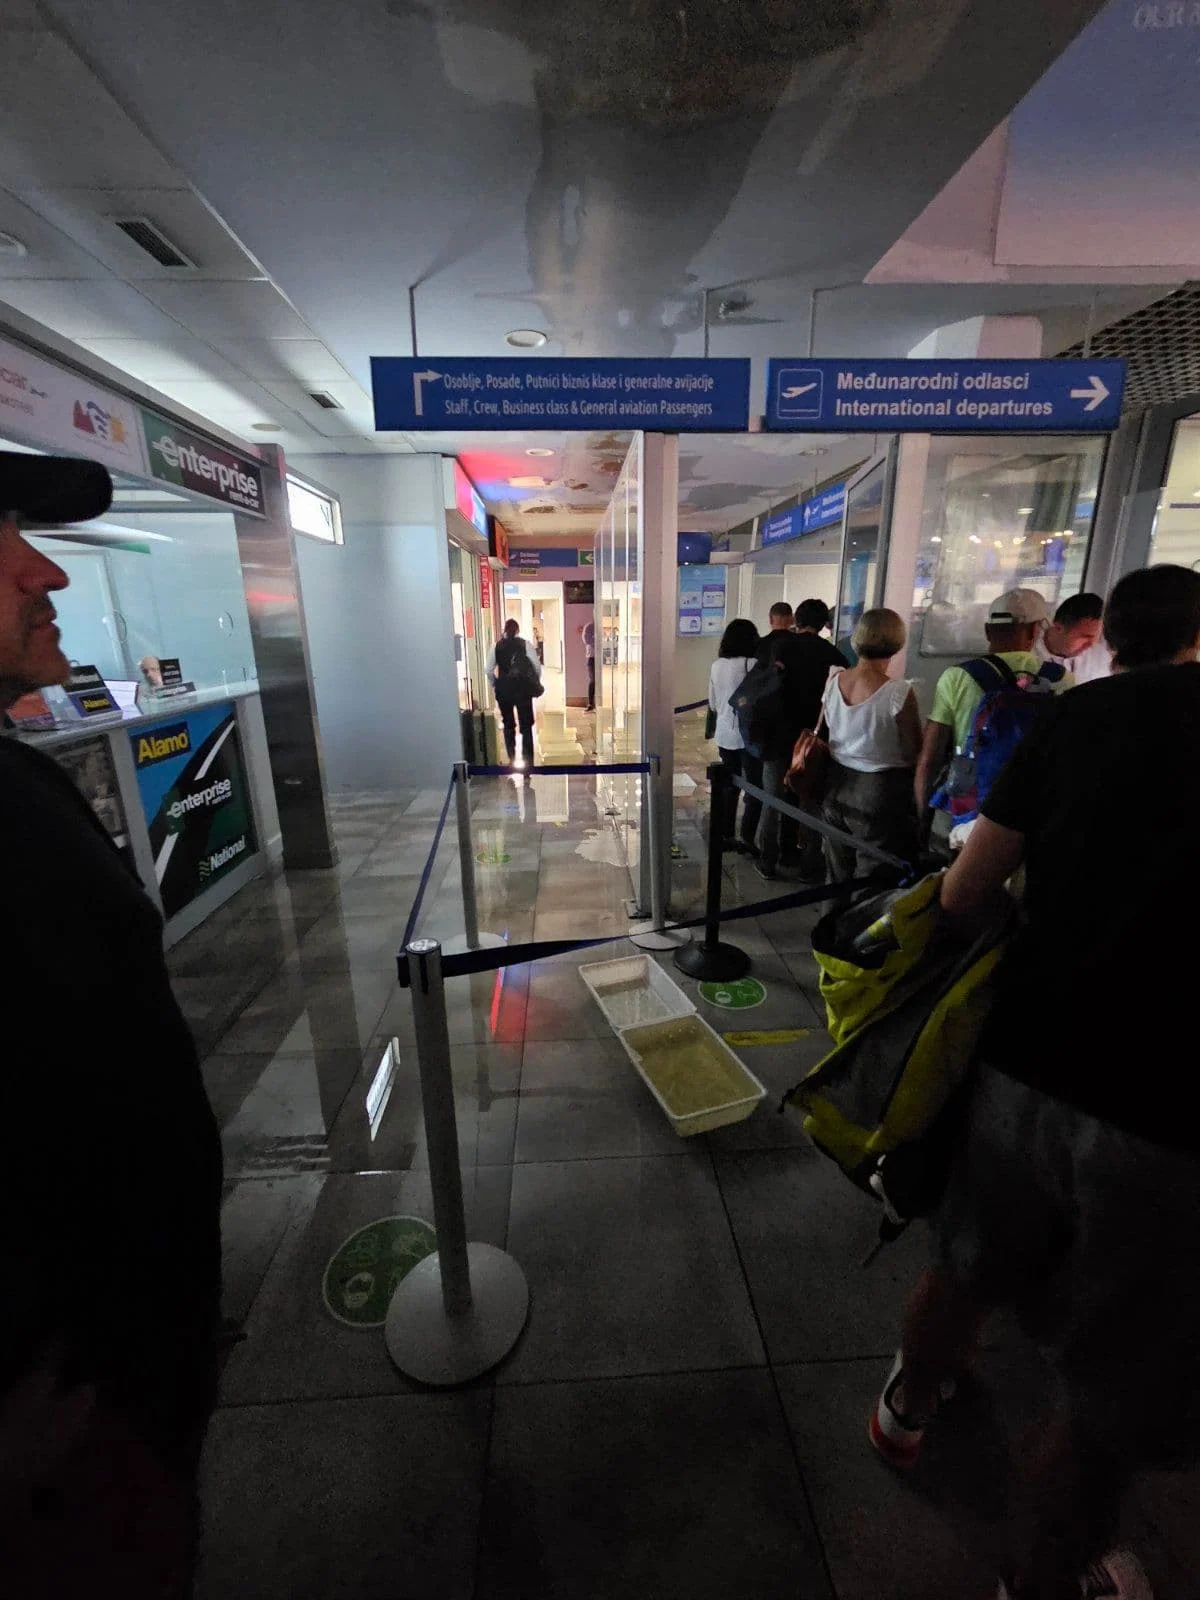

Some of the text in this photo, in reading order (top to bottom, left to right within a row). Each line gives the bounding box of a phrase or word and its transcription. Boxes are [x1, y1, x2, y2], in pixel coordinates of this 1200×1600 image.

[443, 373, 484, 391] Osoblje,
[486, 373, 524, 391] Posade,
[526, 373, 560, 389] Putnici
[562, 373, 590, 389] biznis
[592, 372, 617, 389] klase
[618, 373, 623, 389] i
[624, 374, 673, 392] generalne
[837, 372, 1030, 390] Međunarodni odlasci
[445, 399, 713, 418] Staff, Crew, Business class & General aviation Passengers
[835, 398, 1053, 419] International departures
[152, 436, 259, 498] enterprise
[137, 730, 189, 763] Alamo
[167, 778, 232, 818] enterprise
[210, 834, 246, 871] National
